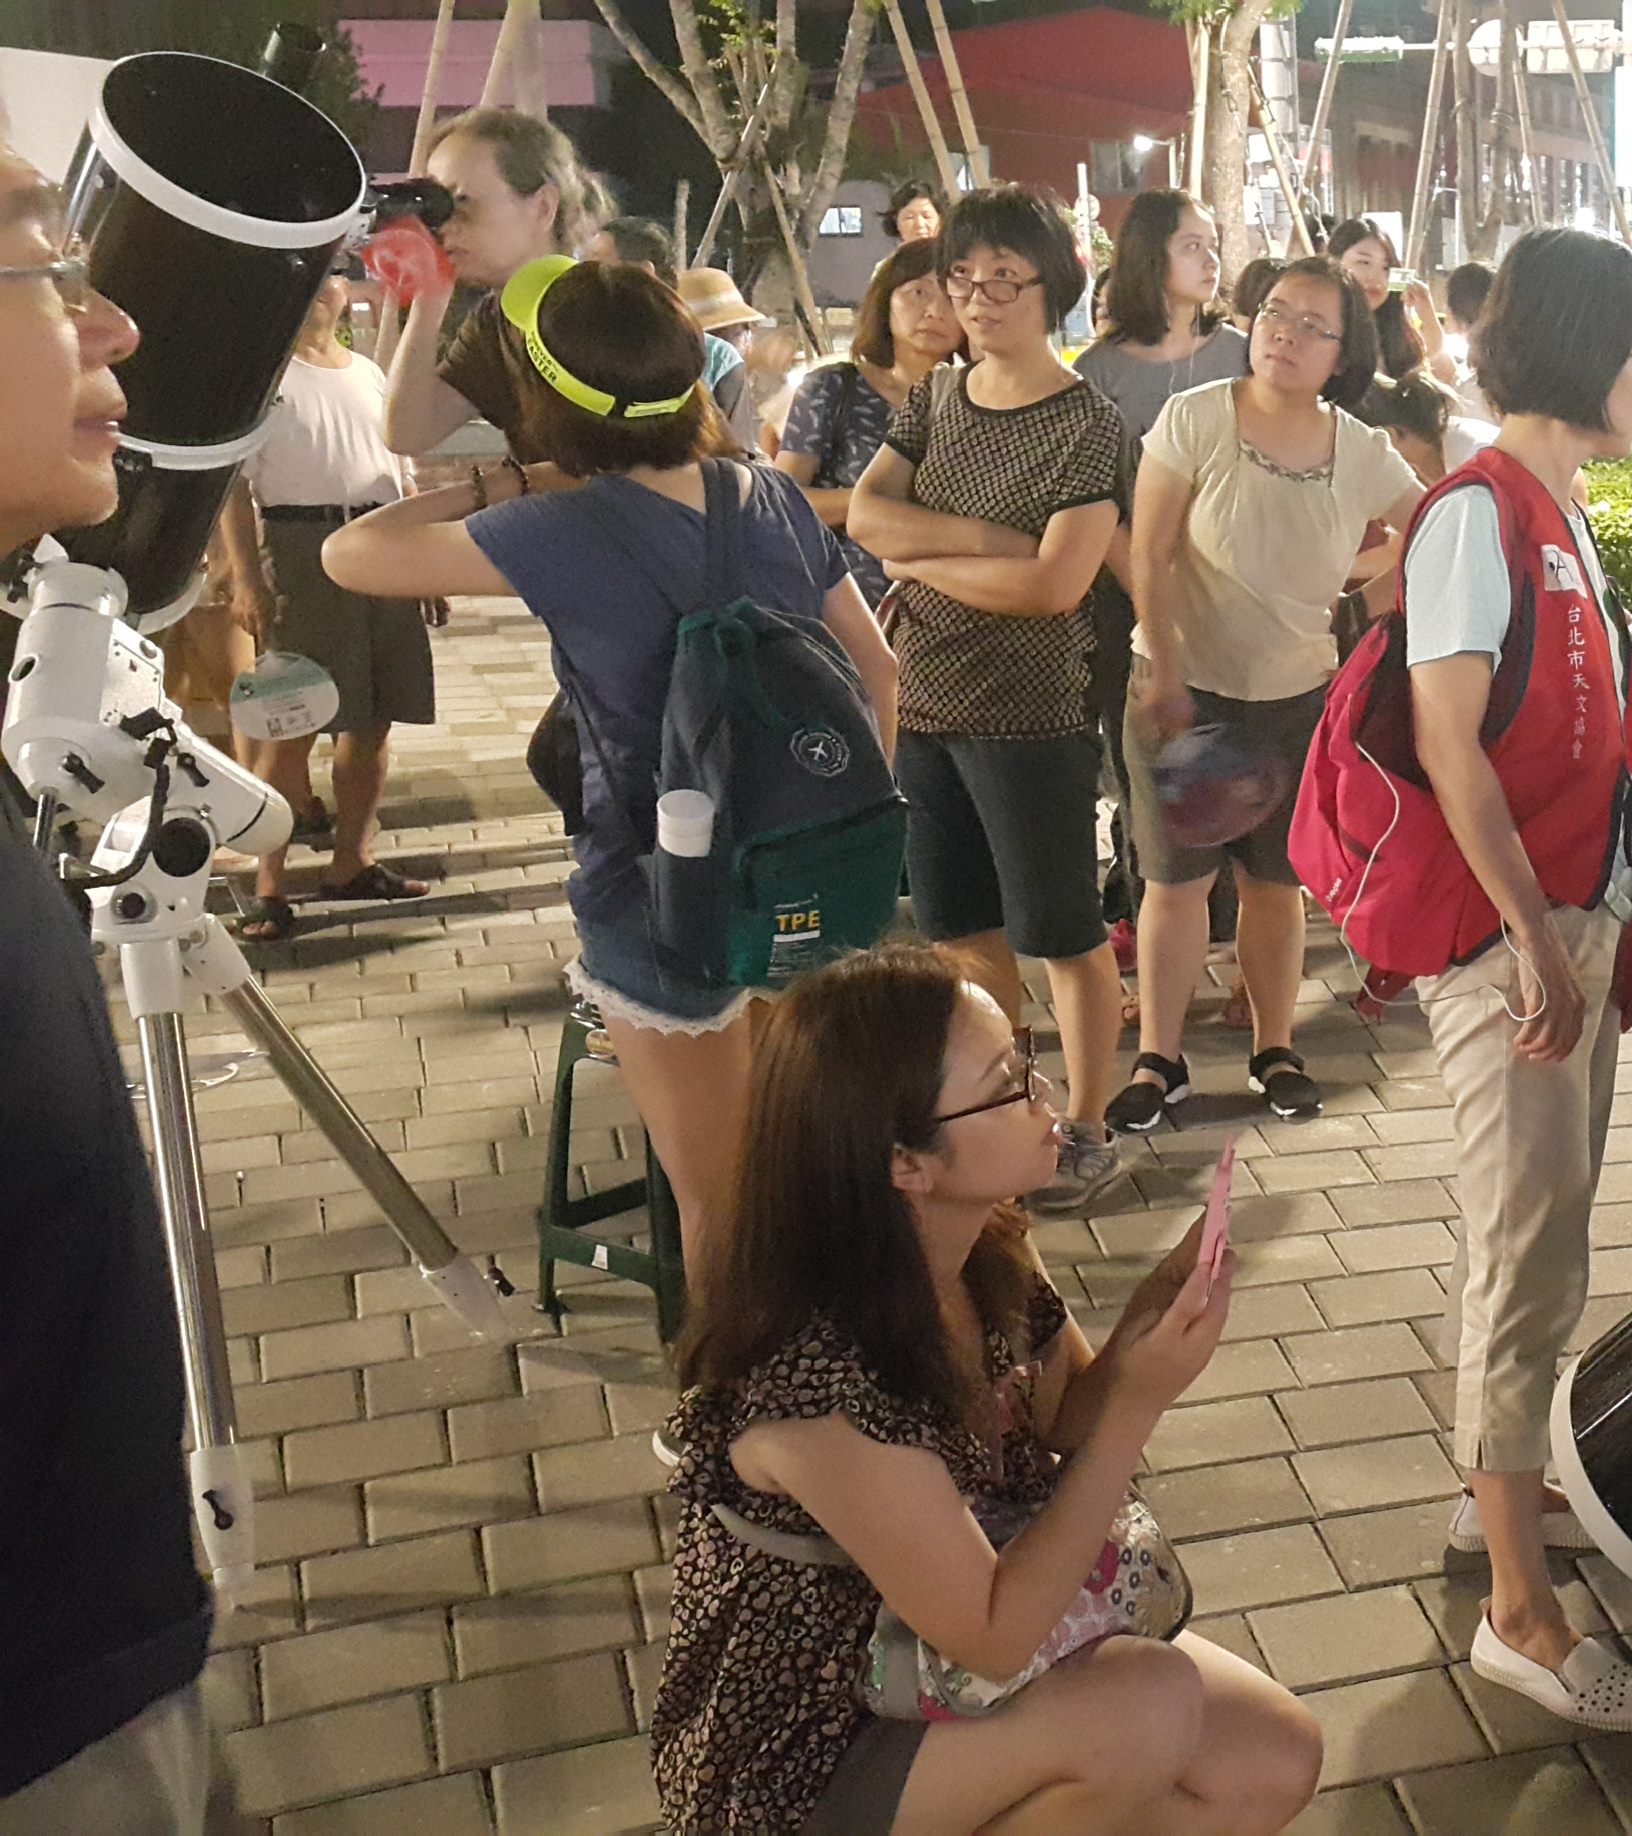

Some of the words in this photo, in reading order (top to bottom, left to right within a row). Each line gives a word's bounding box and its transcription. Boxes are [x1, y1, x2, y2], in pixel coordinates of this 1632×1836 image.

[1567, 603, 1590, 760] 台北市天文協會
[775, 909, 820, 932] TPE
